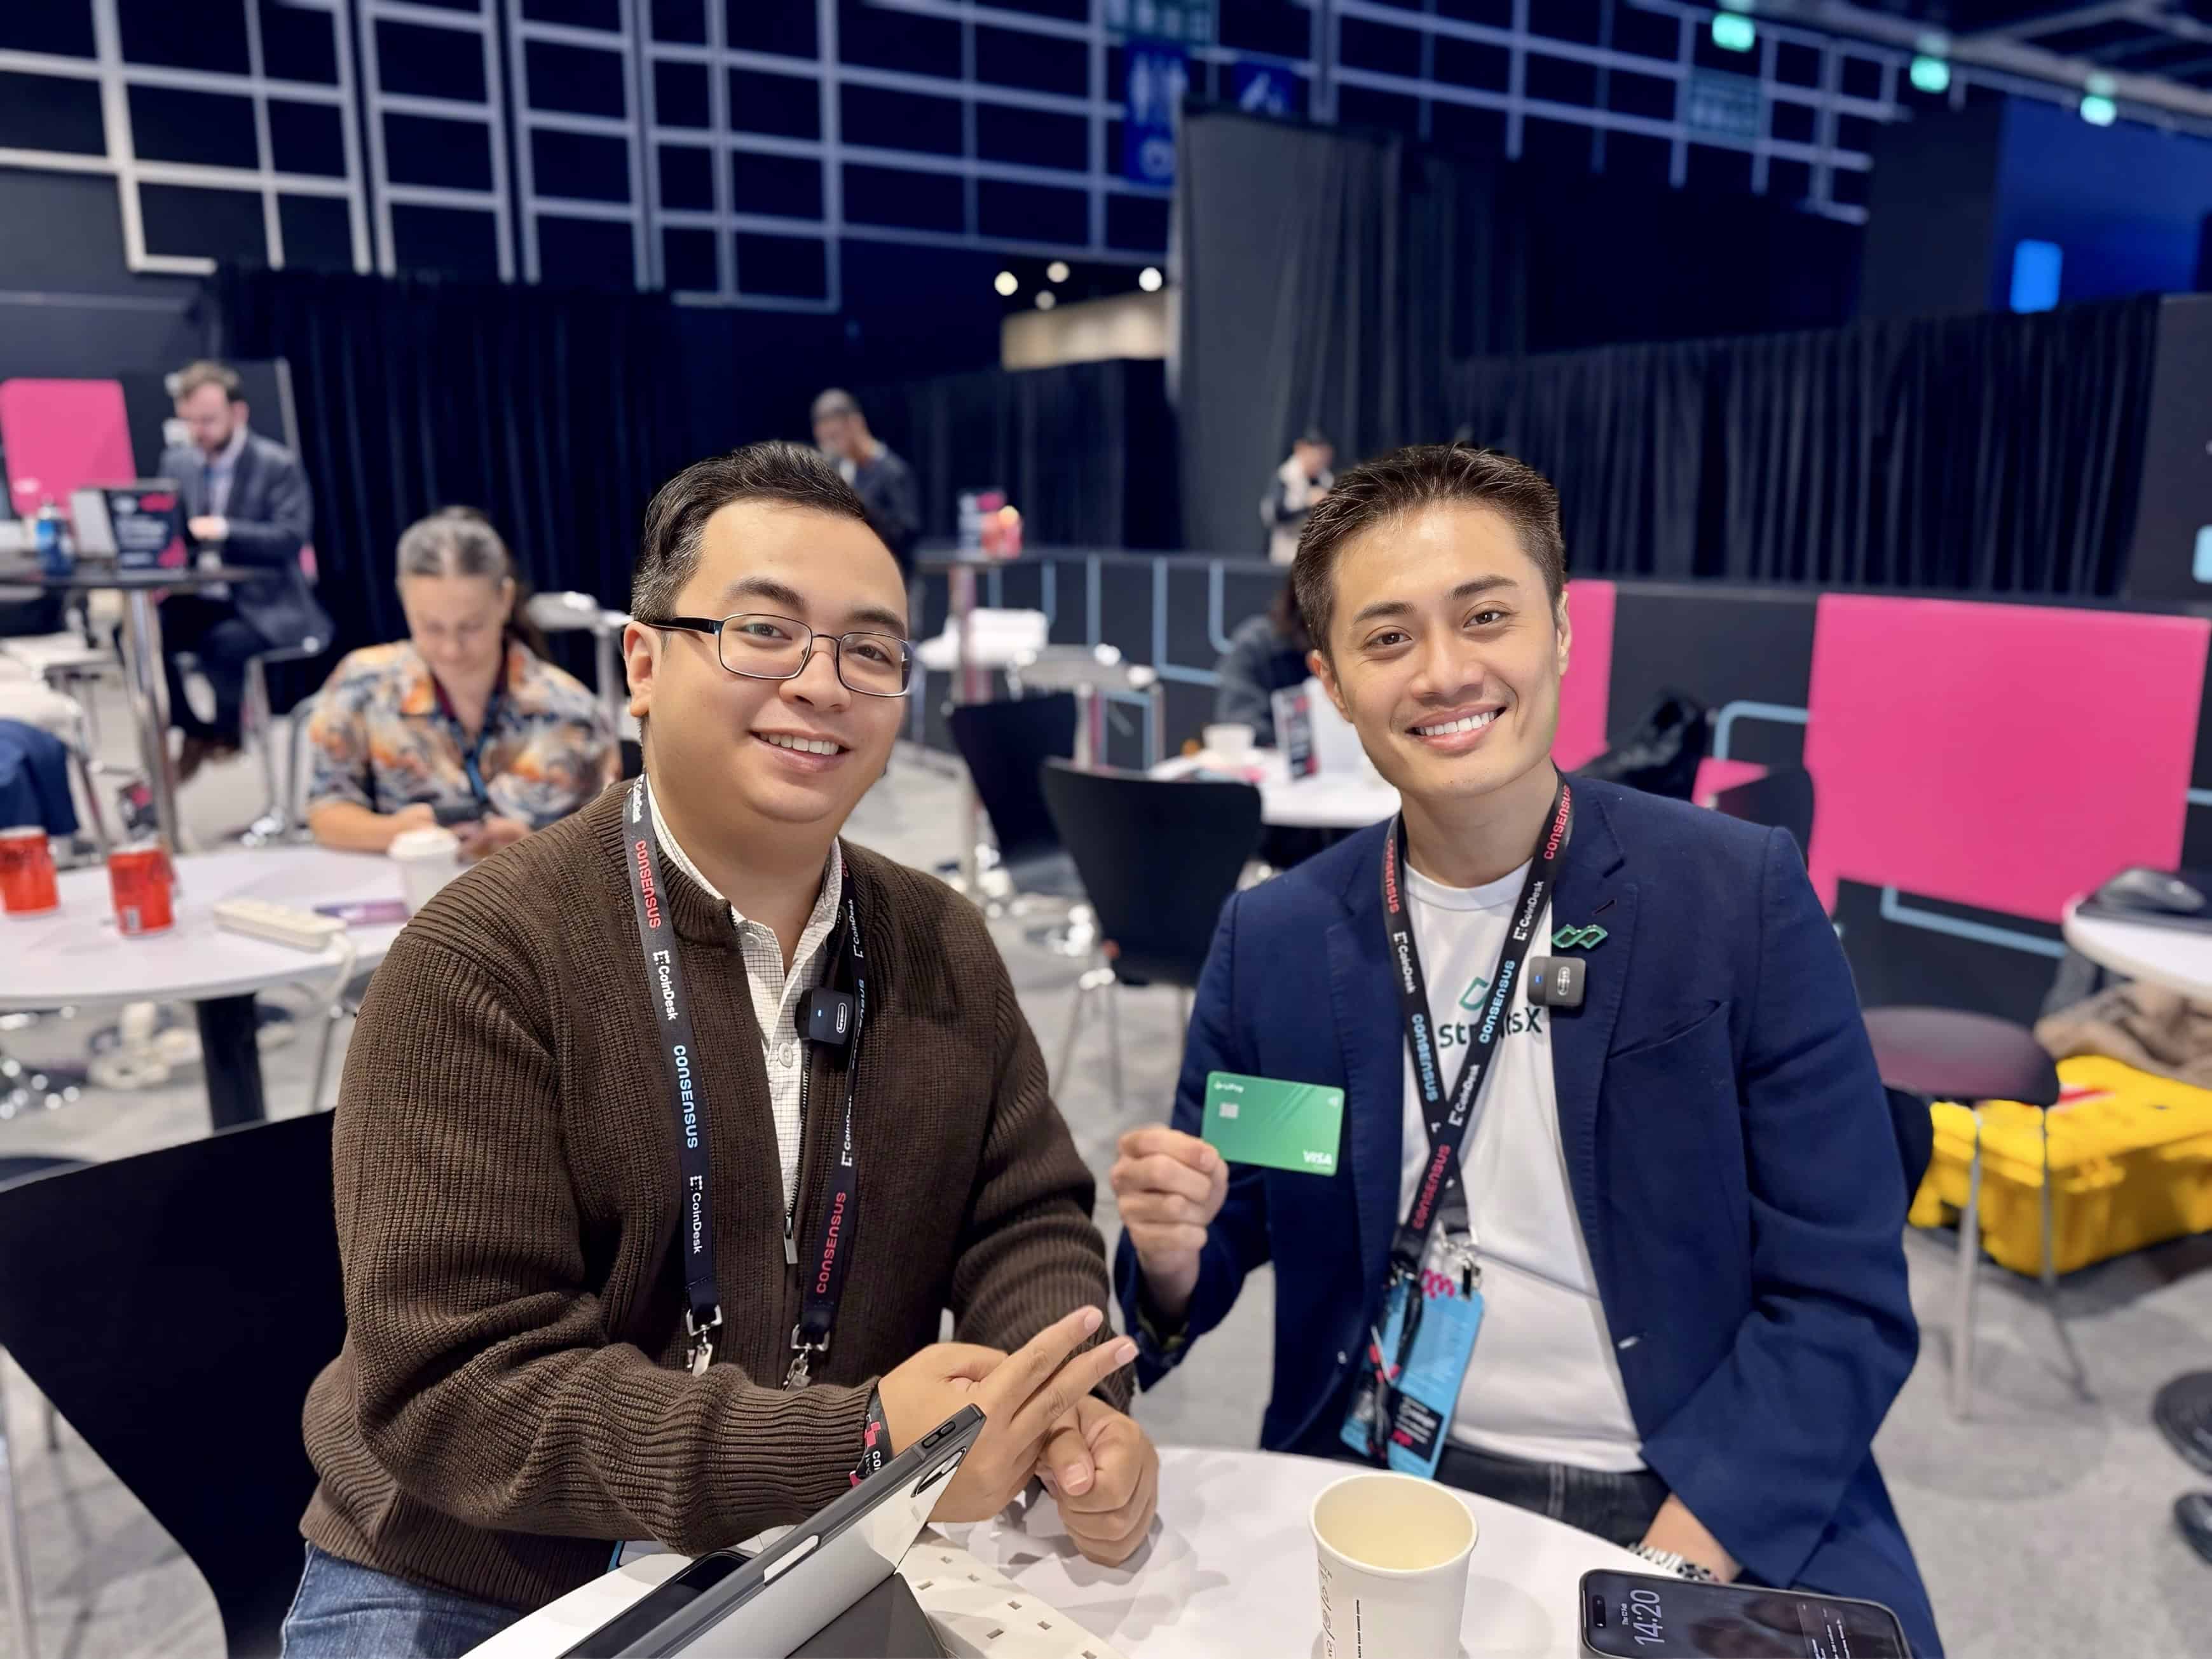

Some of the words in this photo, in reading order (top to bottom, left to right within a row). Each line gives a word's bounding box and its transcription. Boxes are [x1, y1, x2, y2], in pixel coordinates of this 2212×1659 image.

[658, 966, 678, 1021] CoinDesk
[1303, 1150, 1333, 1166] VISA
[692, 1192, 702, 1254] CoinDesk
[1630, 1590, 1665, 1645] 14:20
